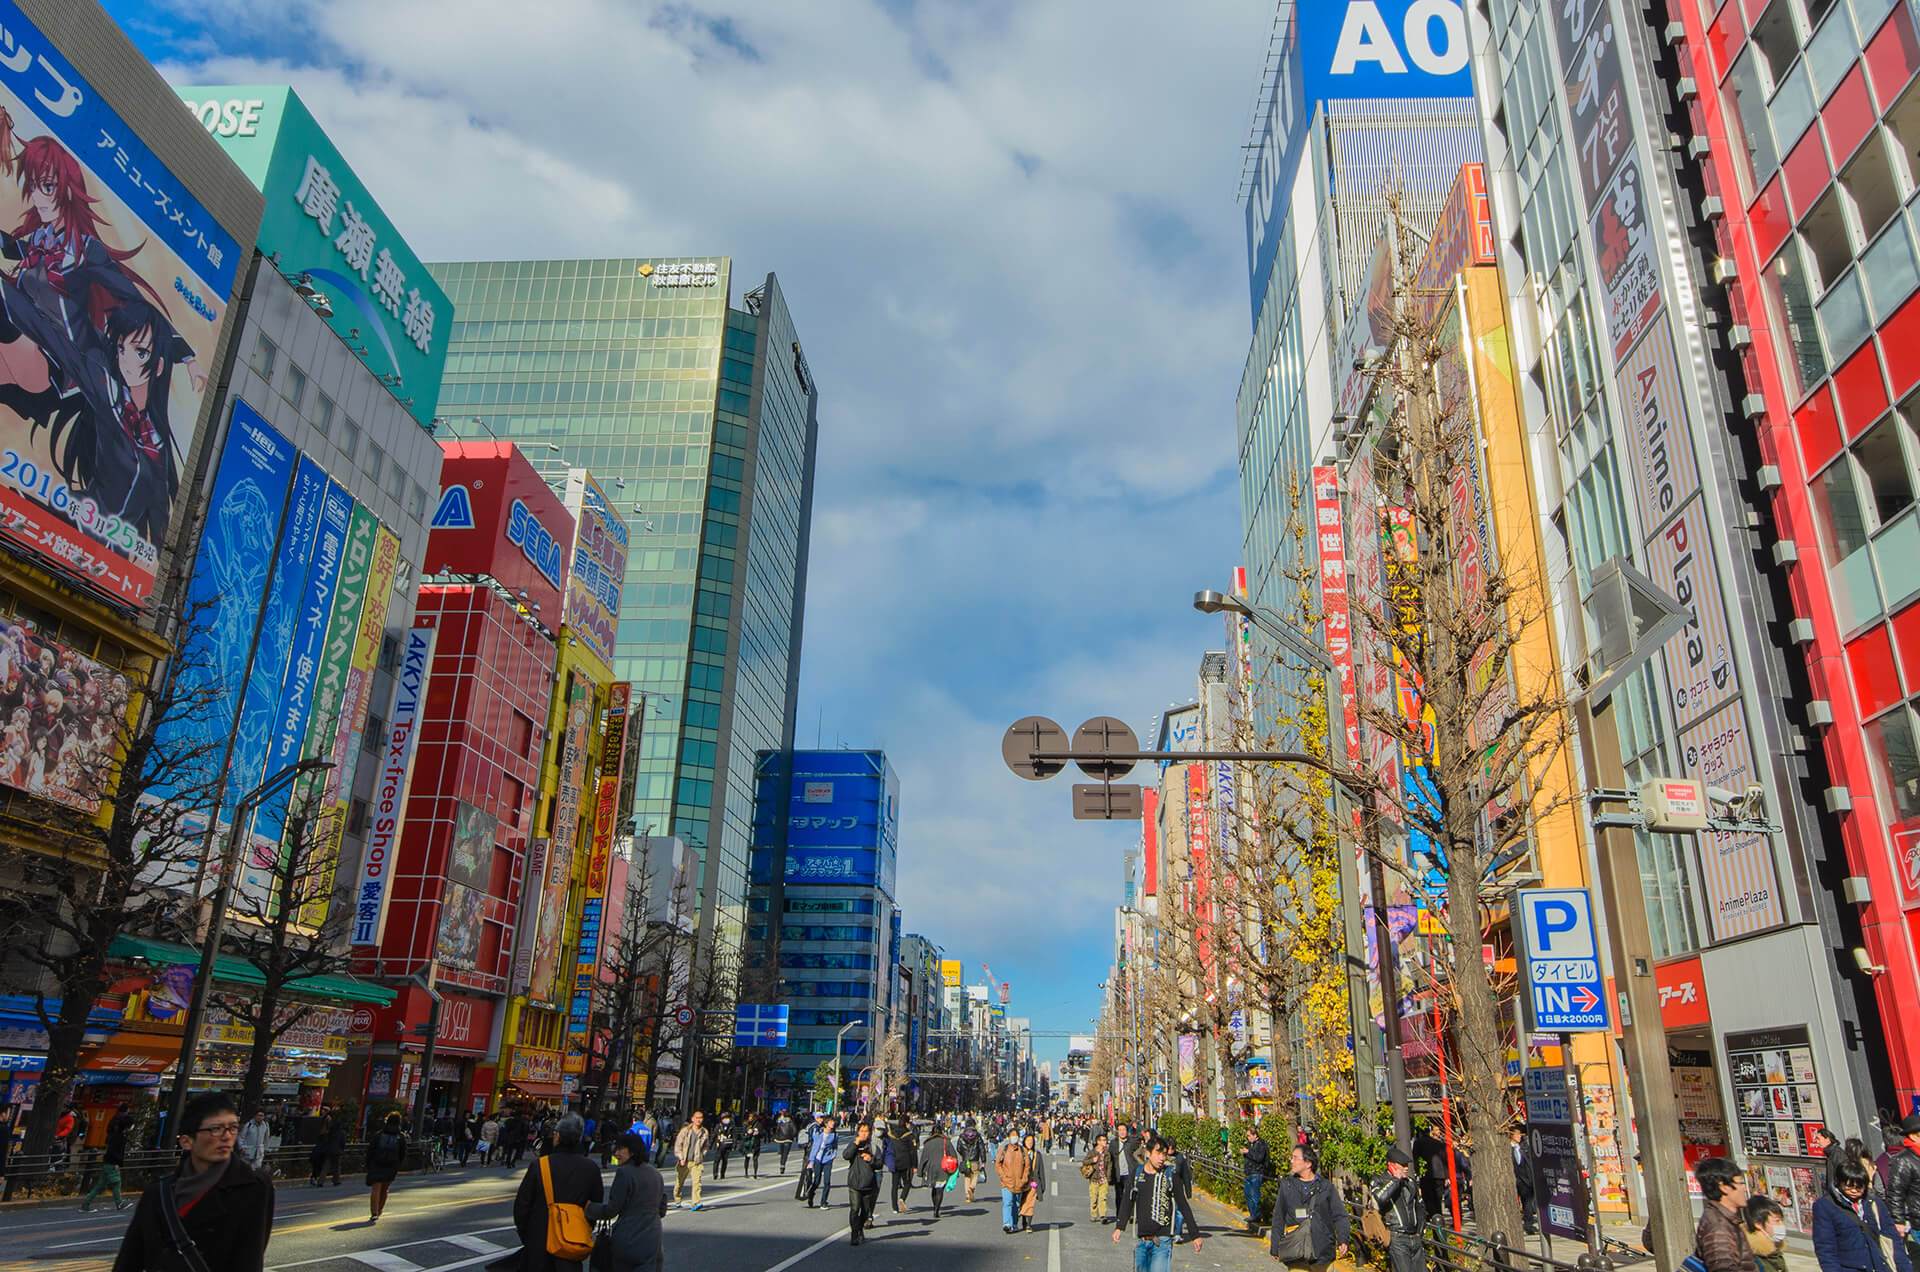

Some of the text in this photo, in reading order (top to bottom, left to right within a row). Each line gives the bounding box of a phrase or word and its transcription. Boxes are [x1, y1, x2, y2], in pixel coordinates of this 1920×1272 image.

[97, 129, 223, 270] アミューズメント館
[295, 155, 440, 355] 廣瀬無線
[656, 263, 716, 275] 住友不動産
[1629, 313, 1644, 339] 5F
[250, 427, 277, 455] Hey
[1637, 365, 1674, 513] Anime
[506, 498, 564, 592] SEGA
[574, 546, 620, 617] 高額買取
[1665, 517, 1704, 669] Plaza
[402, 633, 426, 694] AKKY
[1690, 679, 1709, 699] カフェ
[1700, 727, 1742, 757] キャラクター
[379, 717, 413, 814] Tax-free
[1703, 754, 1725, 775] グッズ
[367, 818, 394, 878] Shop
[530, 843, 545, 877] GAME
[1719, 888, 1769, 914] AnimePlaza
[1534, 900, 1578, 951] P
[1536, 962, 1594, 981] ダイビル
[679, 1010, 691, 1022] 50
[1535, 986, 1570, 1013] IN
[449, 1001, 472, 1041] SEGA
